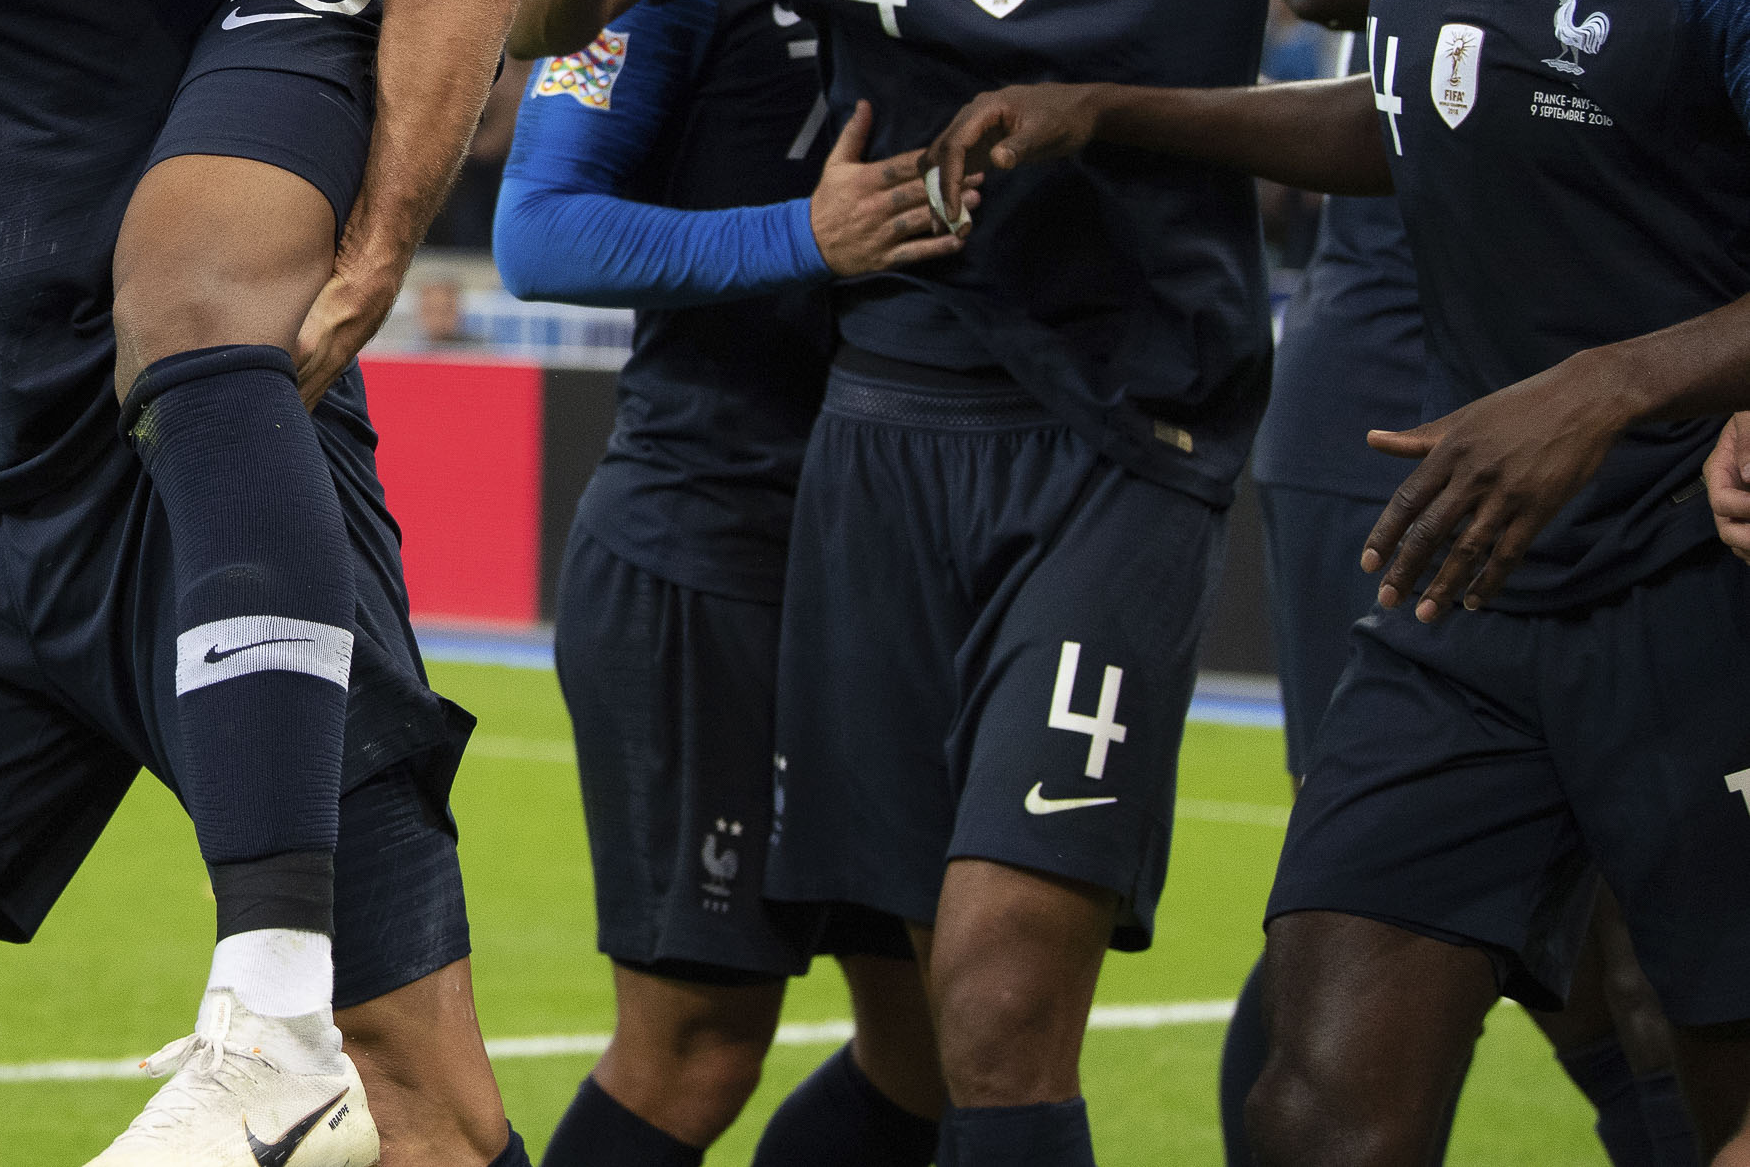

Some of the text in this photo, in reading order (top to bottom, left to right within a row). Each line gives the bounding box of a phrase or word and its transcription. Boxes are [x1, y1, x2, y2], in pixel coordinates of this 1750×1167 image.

[1366, 16, 1403, 156] 4
[1444, 89, 1463, 102] FIFA
[1530, 104, 1538, 116] 9
[1539, 105, 1586, 123] SEPTEMBRE
[1048, 640, 1127, 780] 4
[328, 1104, 350, 1131] MBAPPE
